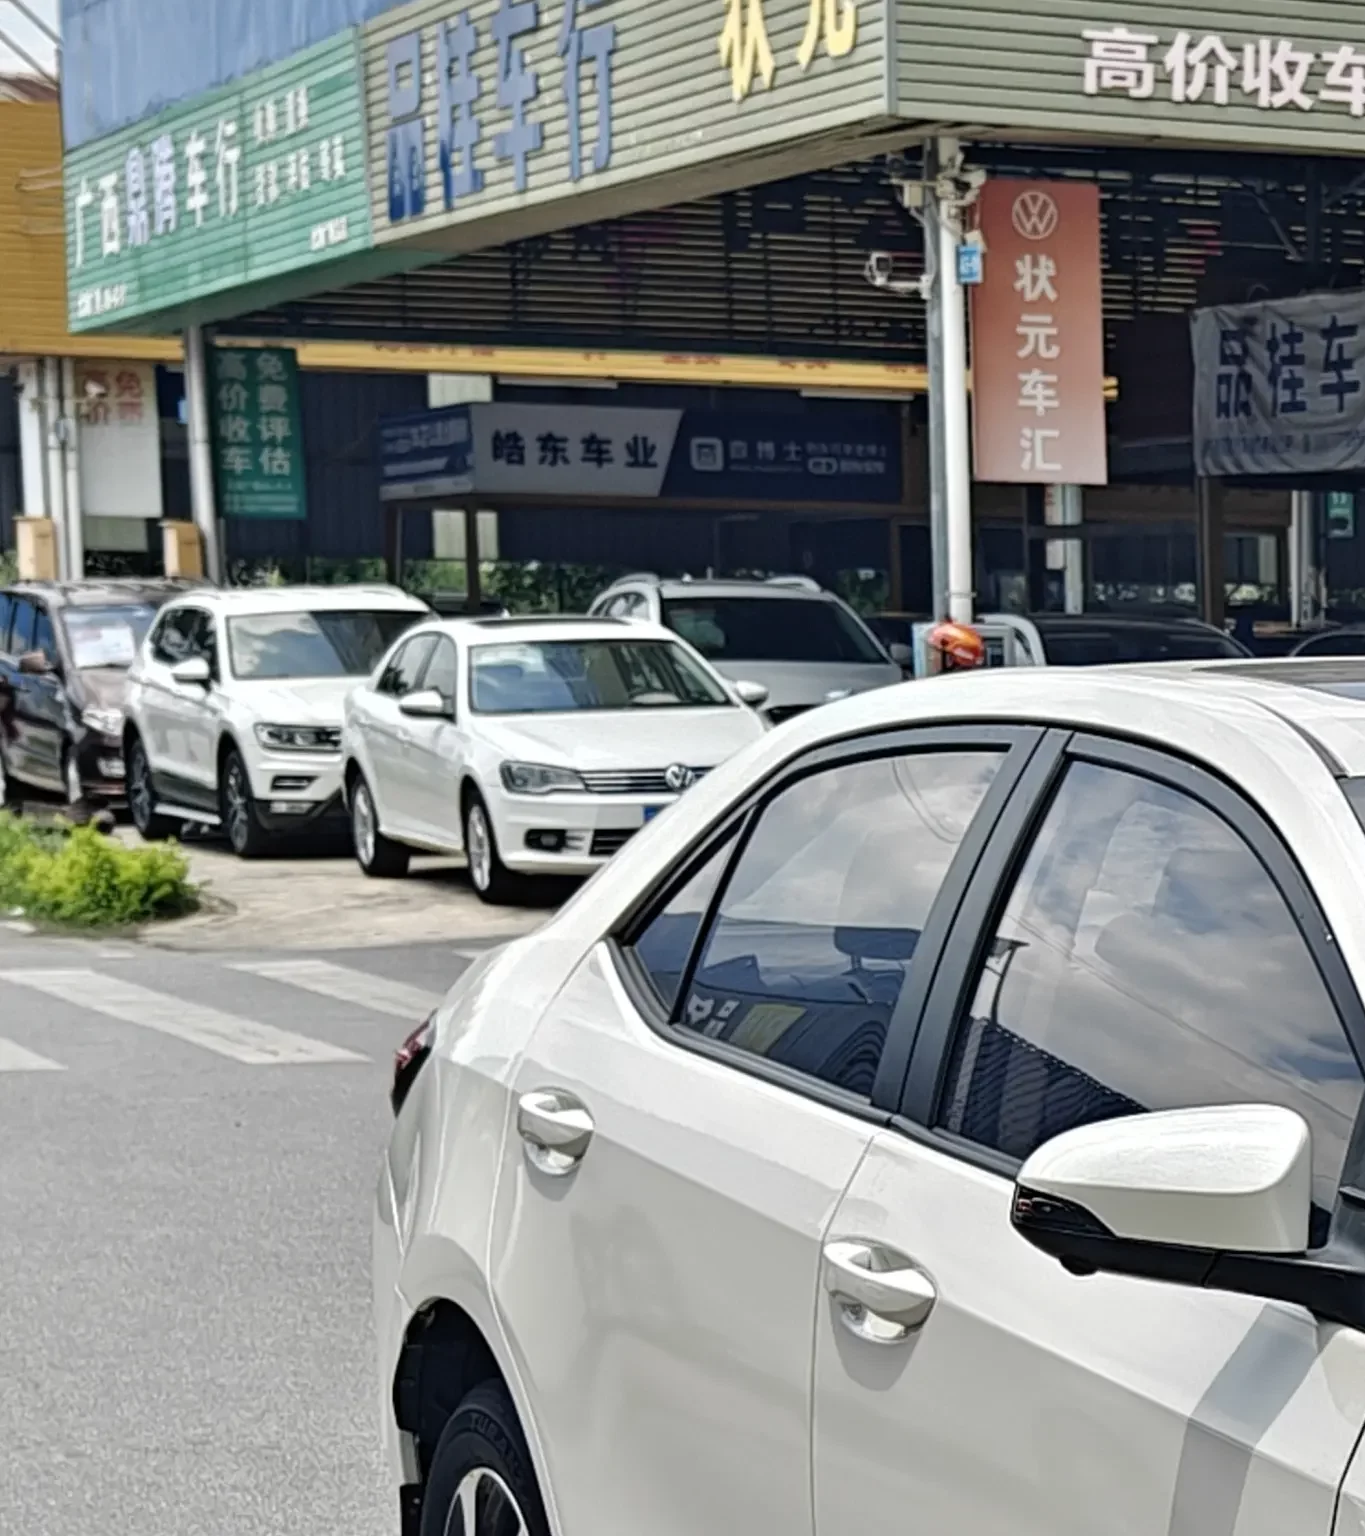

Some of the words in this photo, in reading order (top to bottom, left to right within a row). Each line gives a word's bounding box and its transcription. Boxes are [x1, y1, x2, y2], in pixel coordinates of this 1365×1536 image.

[216, 352, 252, 475] 高价收车
[256, 352, 292, 475] 免费评估
[1013, 254, 1063, 471] 状元车汇
